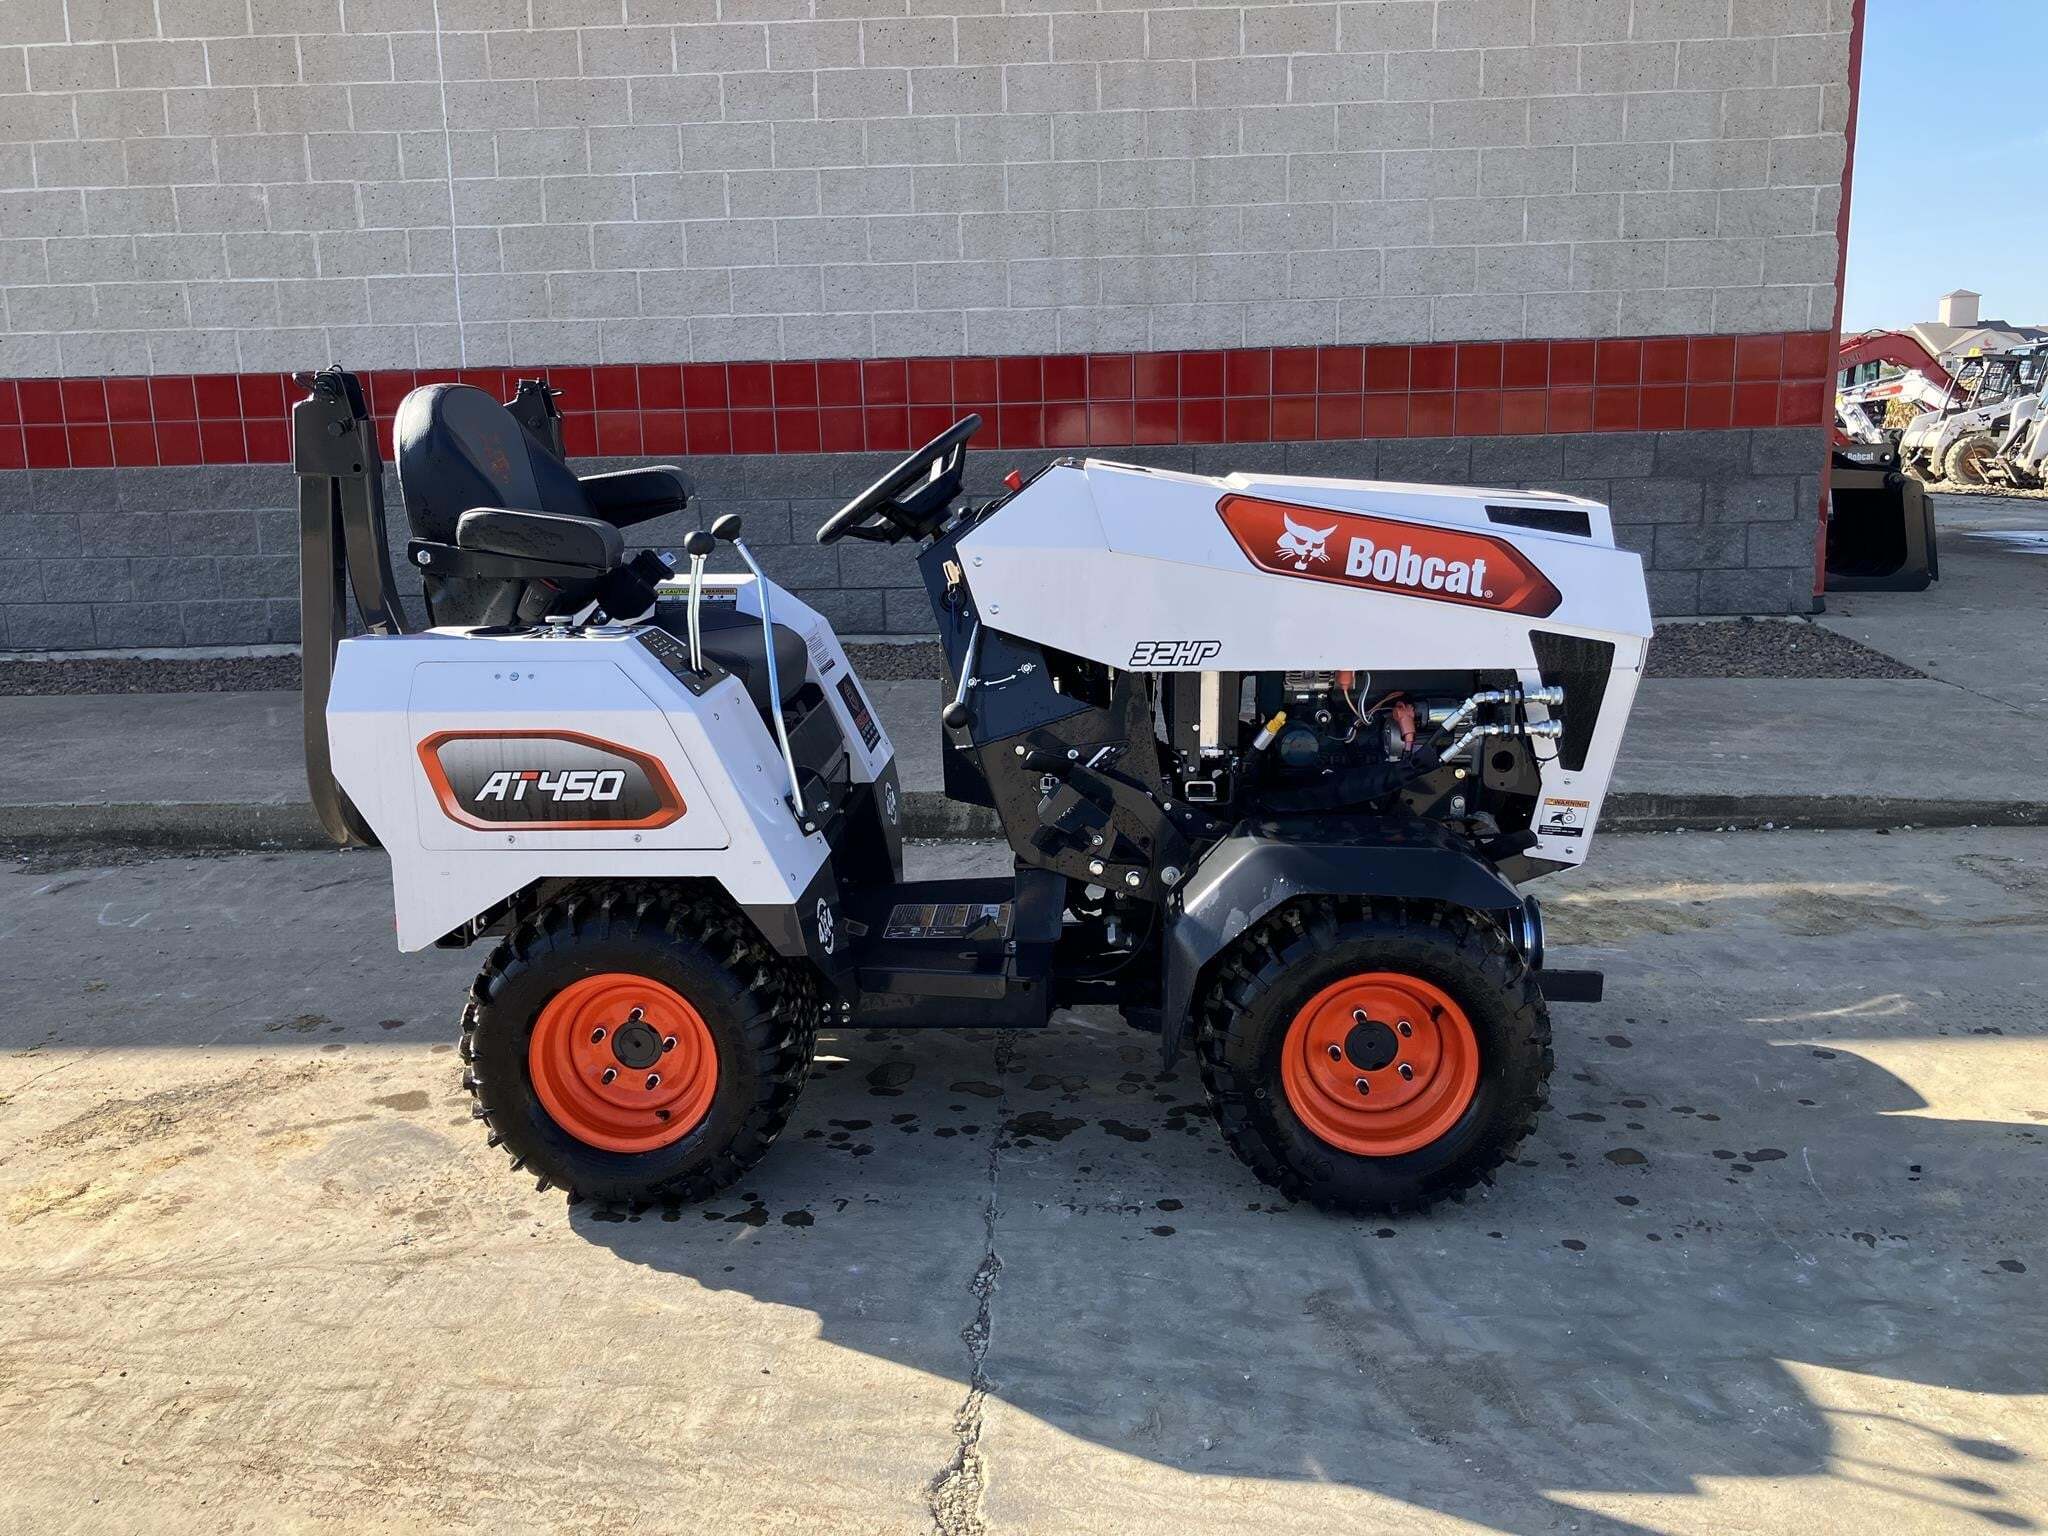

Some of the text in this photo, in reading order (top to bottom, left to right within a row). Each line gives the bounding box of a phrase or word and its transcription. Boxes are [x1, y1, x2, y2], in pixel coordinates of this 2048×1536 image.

[1847, 451, 1874, 461] Bobcat
[1345, 536, 1486, 598] Bobcat
[1128, 640, 1222, 667] 32HP
[474, 769, 627, 802] AT450
[1554, 799, 1587, 807] WARNING
